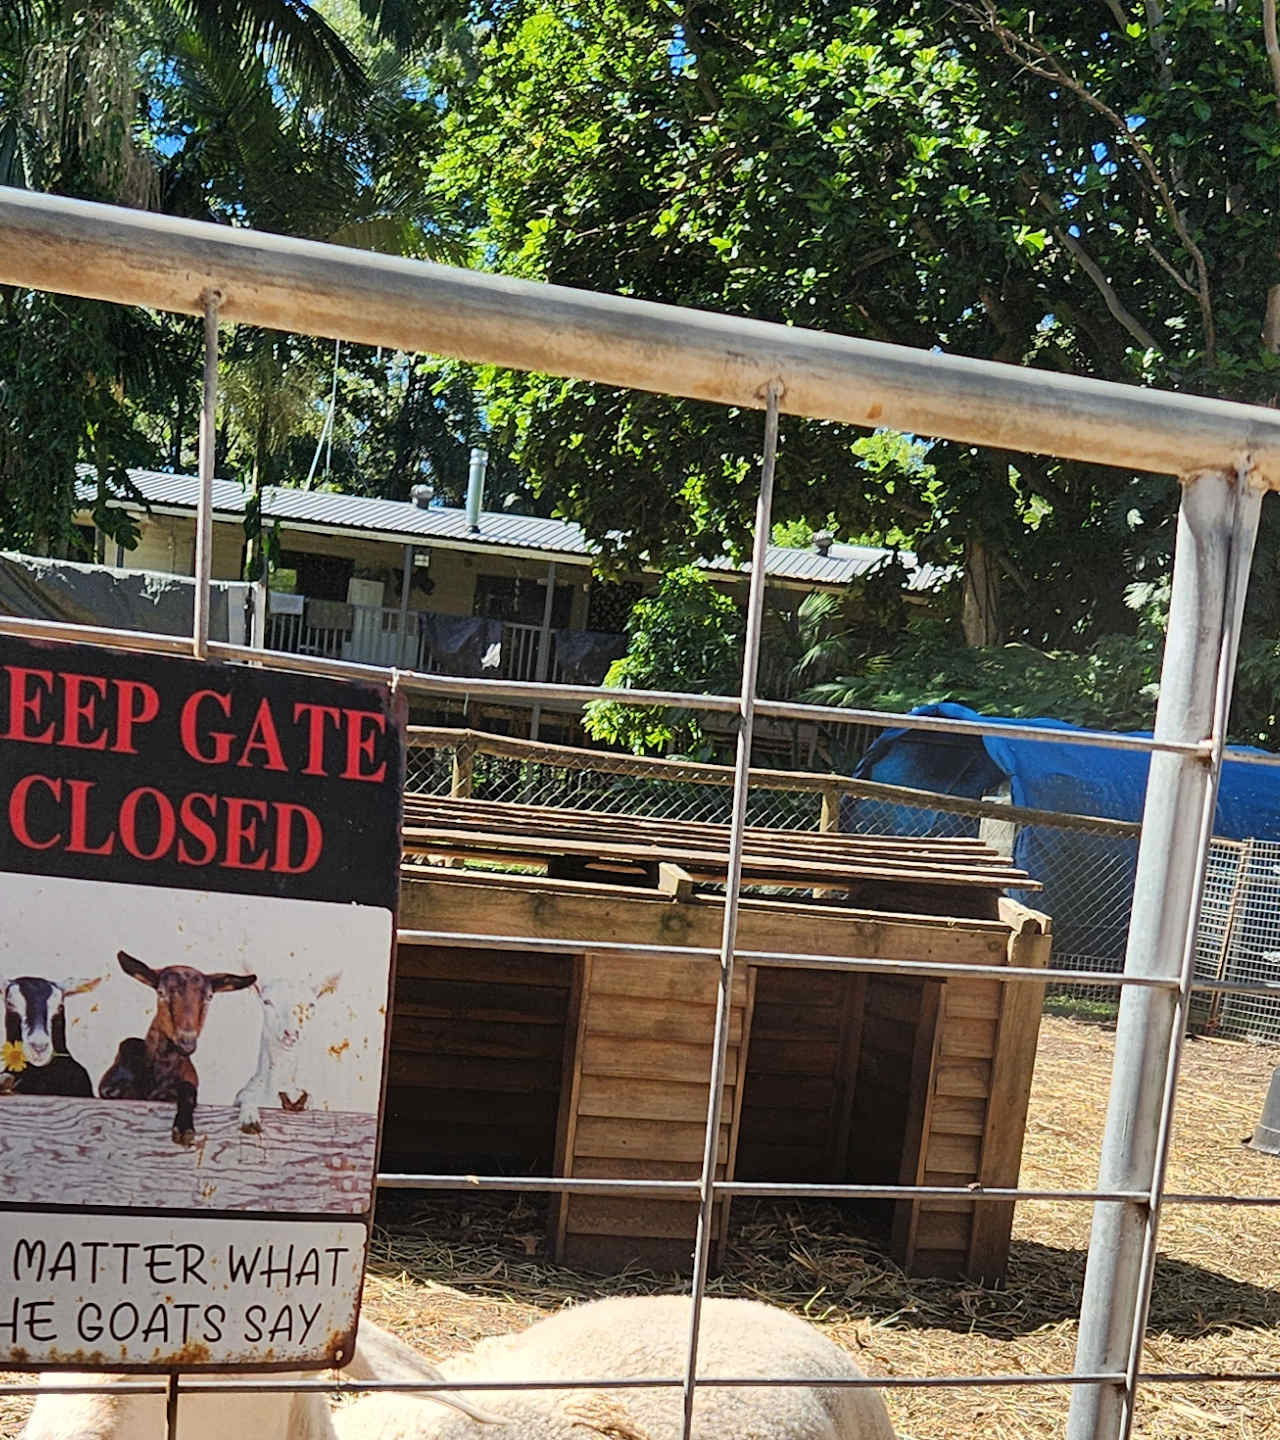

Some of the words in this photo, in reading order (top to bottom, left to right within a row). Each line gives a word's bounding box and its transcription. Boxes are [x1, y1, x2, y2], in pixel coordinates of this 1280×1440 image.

[179, 689, 388, 783] GATE
[8, 774, 323, 874] CLOSED
[14, 1240, 208, 1286] MATTER
[228, 1246, 349, 1288] WHAT
[77, 1301, 228, 1345] GOATS
[244, 1303, 322, 1345] SAY
